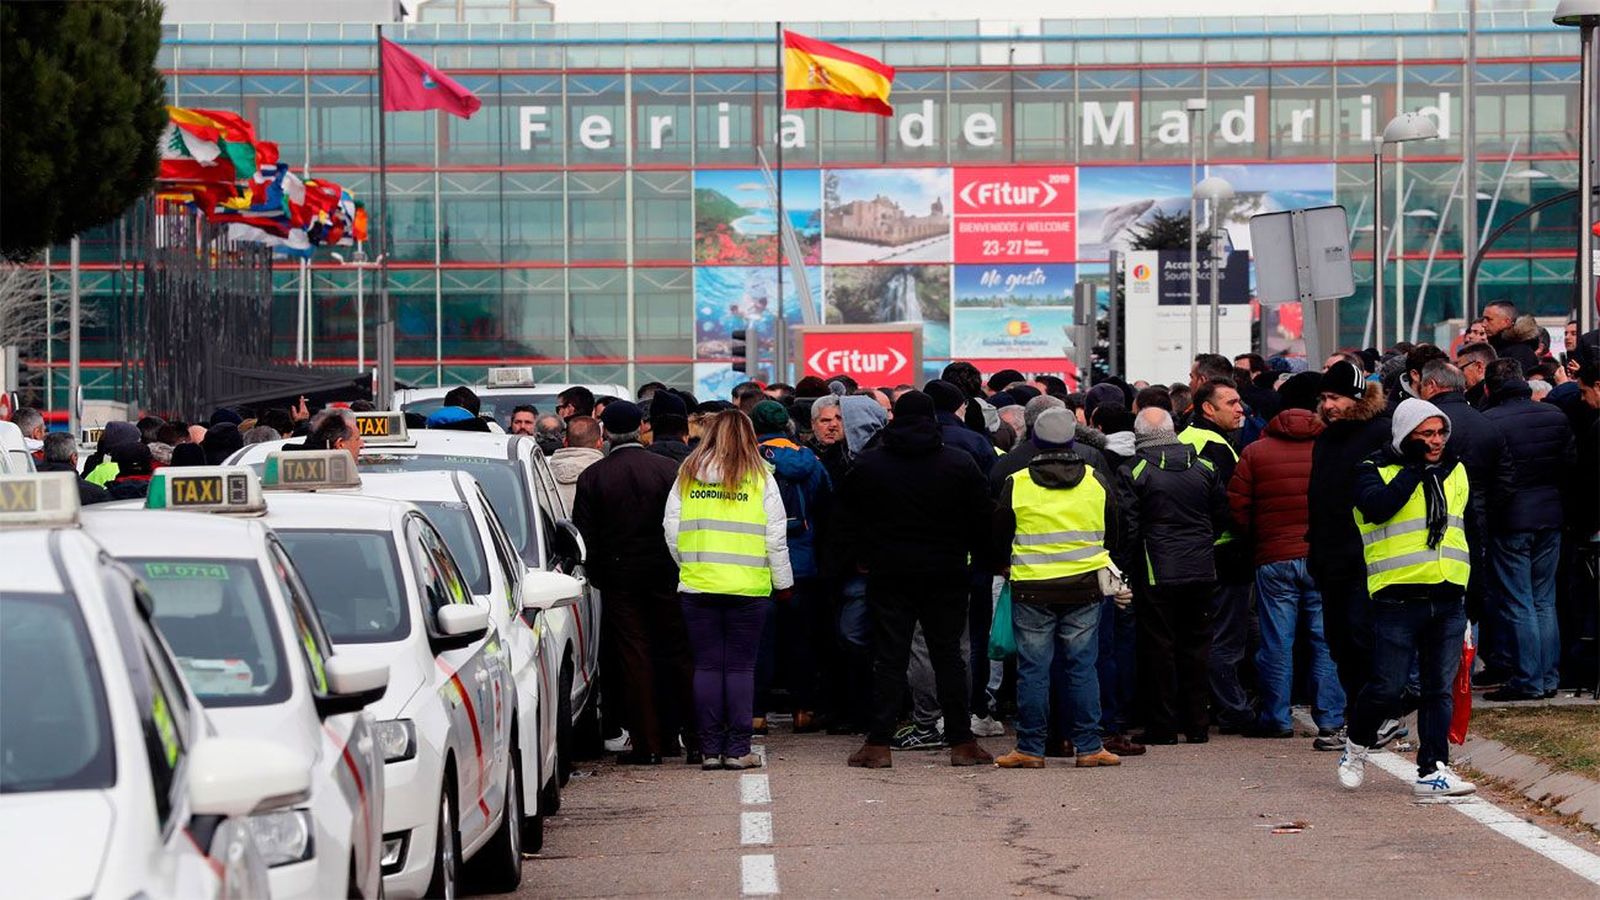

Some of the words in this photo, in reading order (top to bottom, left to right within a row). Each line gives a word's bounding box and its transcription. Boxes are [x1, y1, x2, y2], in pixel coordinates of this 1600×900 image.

[519, 102, 806, 150] Feria
[899, 99, 998, 147] de
[1082, 92, 1451, 146] Madrid
[978, 182, 1040, 205] Fitur
[958, 222, 1018, 233] BIENVENIDOS
[1026, 221, 1071, 232] WELCOME
[1164, 260, 1201, 270] Acceo
[980, 268, 1002, 288] Me
[1005, 266, 1046, 293] gusta
[827, 350, 889, 373] Fitur
[356, 418, 388, 435] TAXI
[285, 459, 325, 481] TAXI
[173, 477, 223, 503] TAXI
